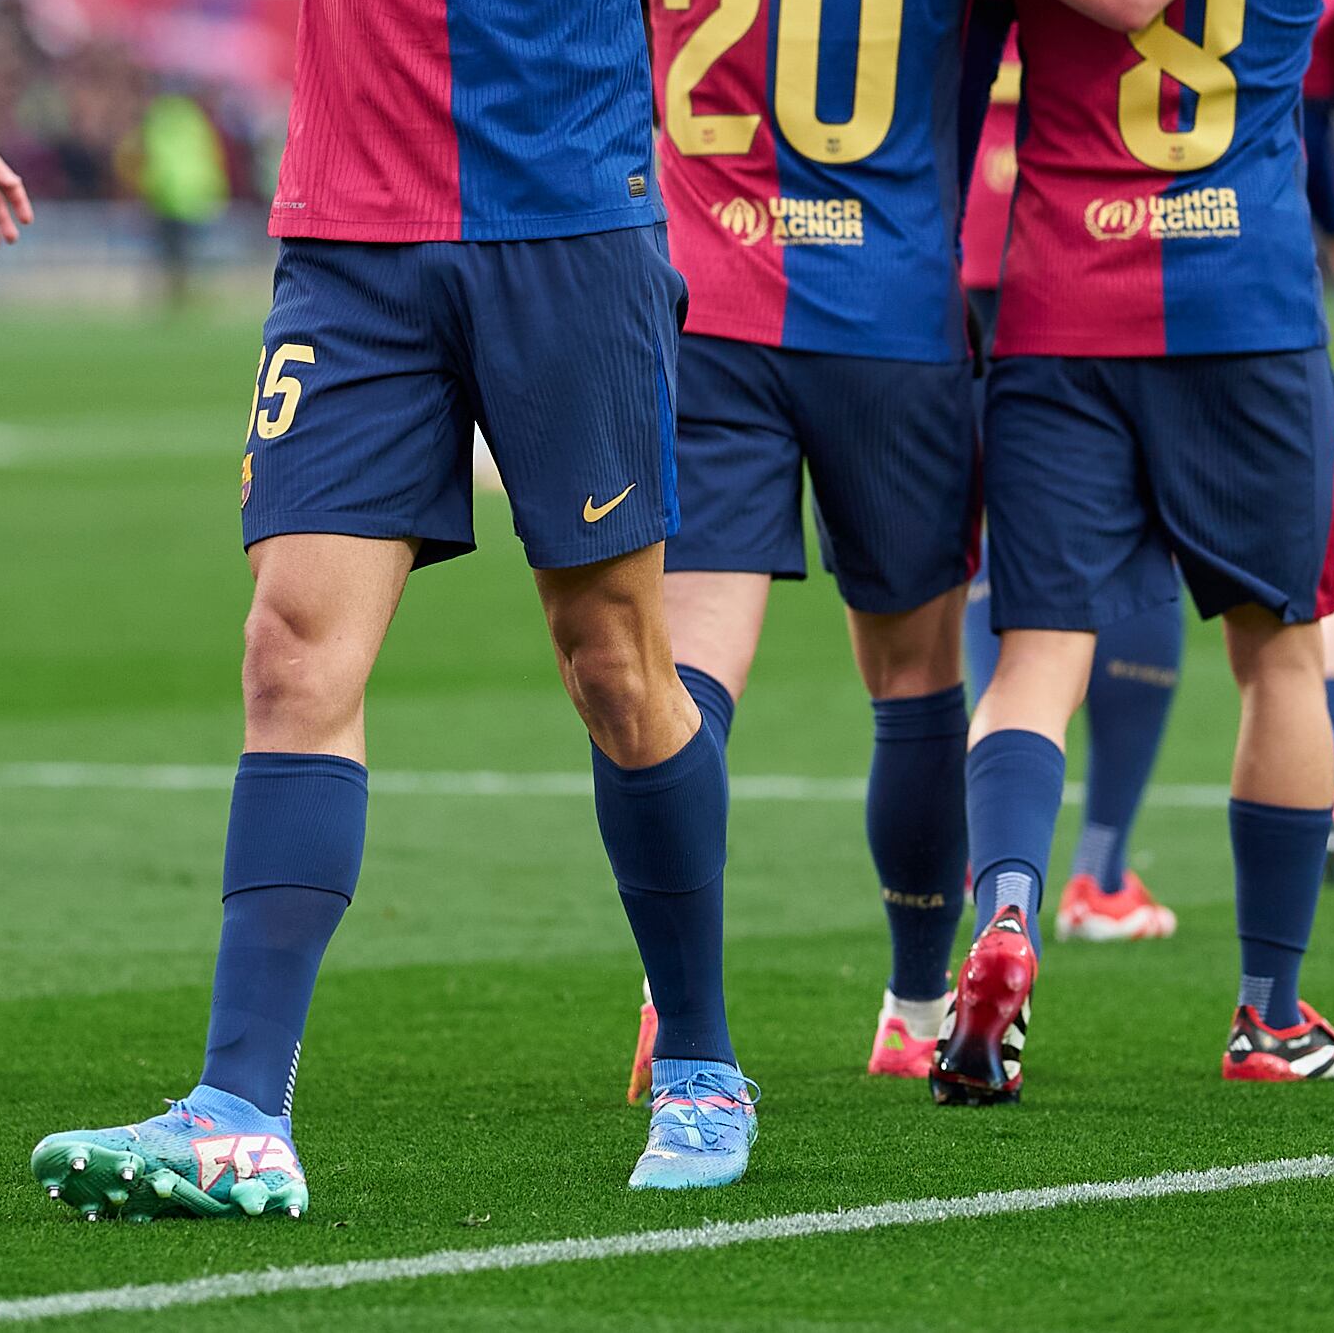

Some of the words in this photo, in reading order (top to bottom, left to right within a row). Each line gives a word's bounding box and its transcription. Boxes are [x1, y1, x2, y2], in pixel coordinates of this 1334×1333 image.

[769, 197, 862, 219] UNHCR
[1149, 187, 1238, 217] UNHCR
[772, 217, 864, 238] ACNUR
[1149, 208, 1240, 233] ACNUR
